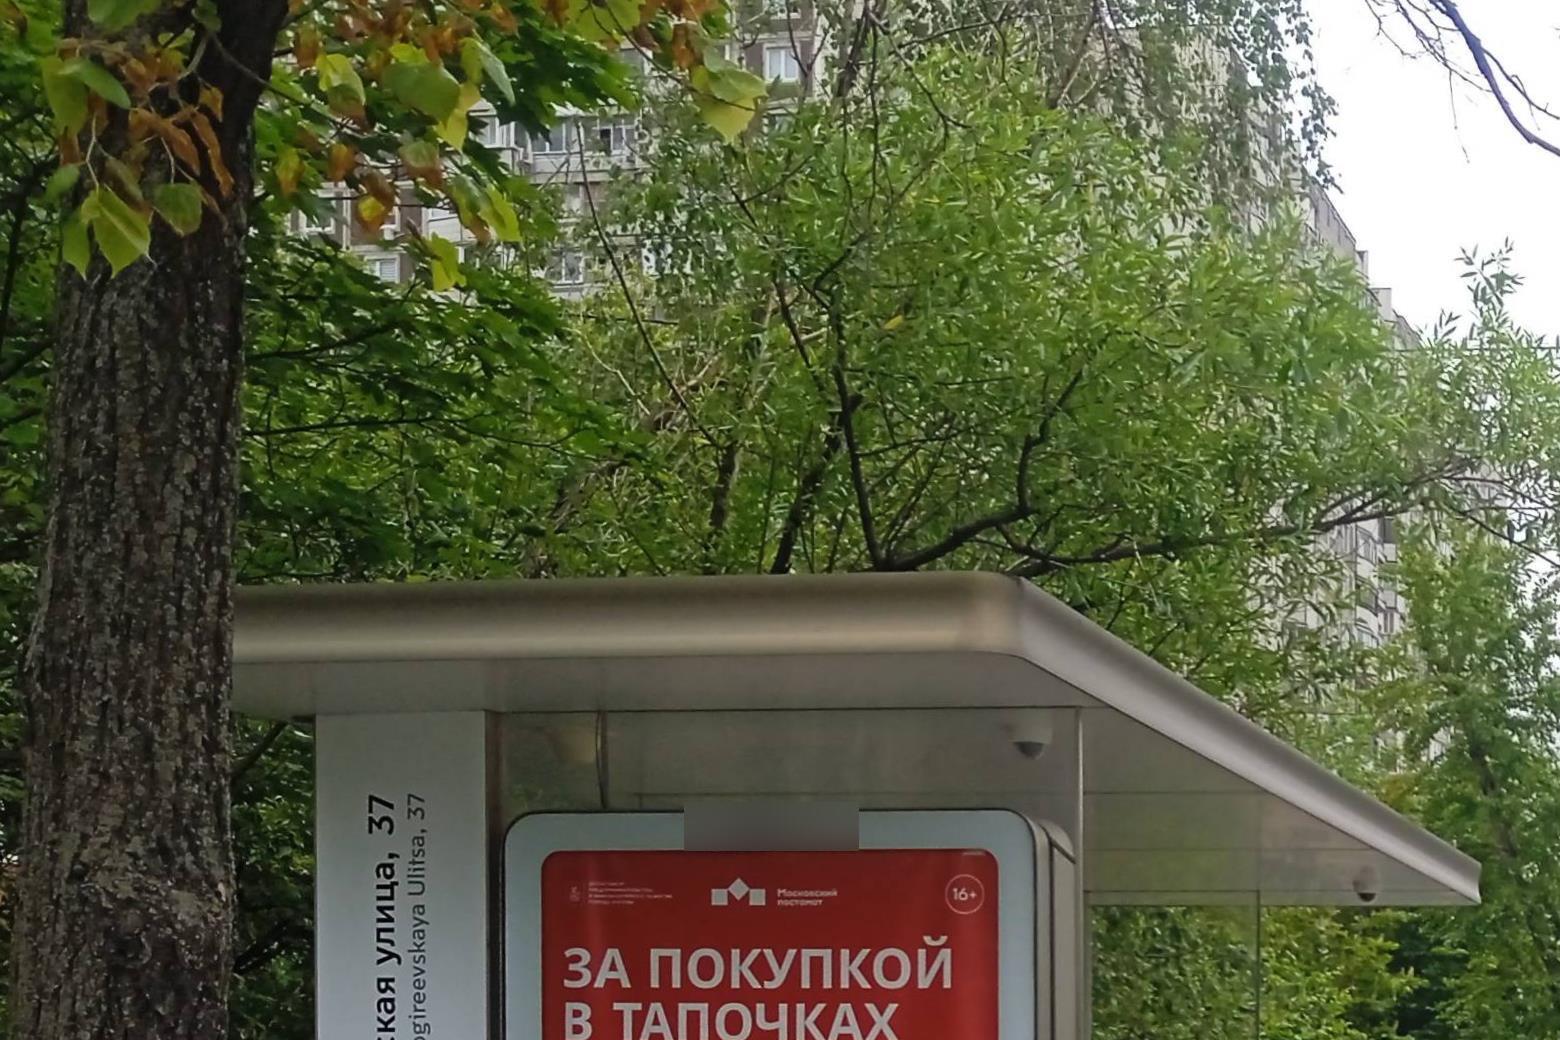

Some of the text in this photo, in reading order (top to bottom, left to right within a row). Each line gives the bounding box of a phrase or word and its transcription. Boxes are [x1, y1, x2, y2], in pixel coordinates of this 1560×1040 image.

[368, 794, 395, 835] 37
[407, 793, 425, 821] 37
[407, 828, 428, 897] Ulitsa,
[375, 852, 402, 966] улица,
[952, 887, 977, 901] 16+
[563, 935, 952, 990] ЗА ПОКУПКОЙ
